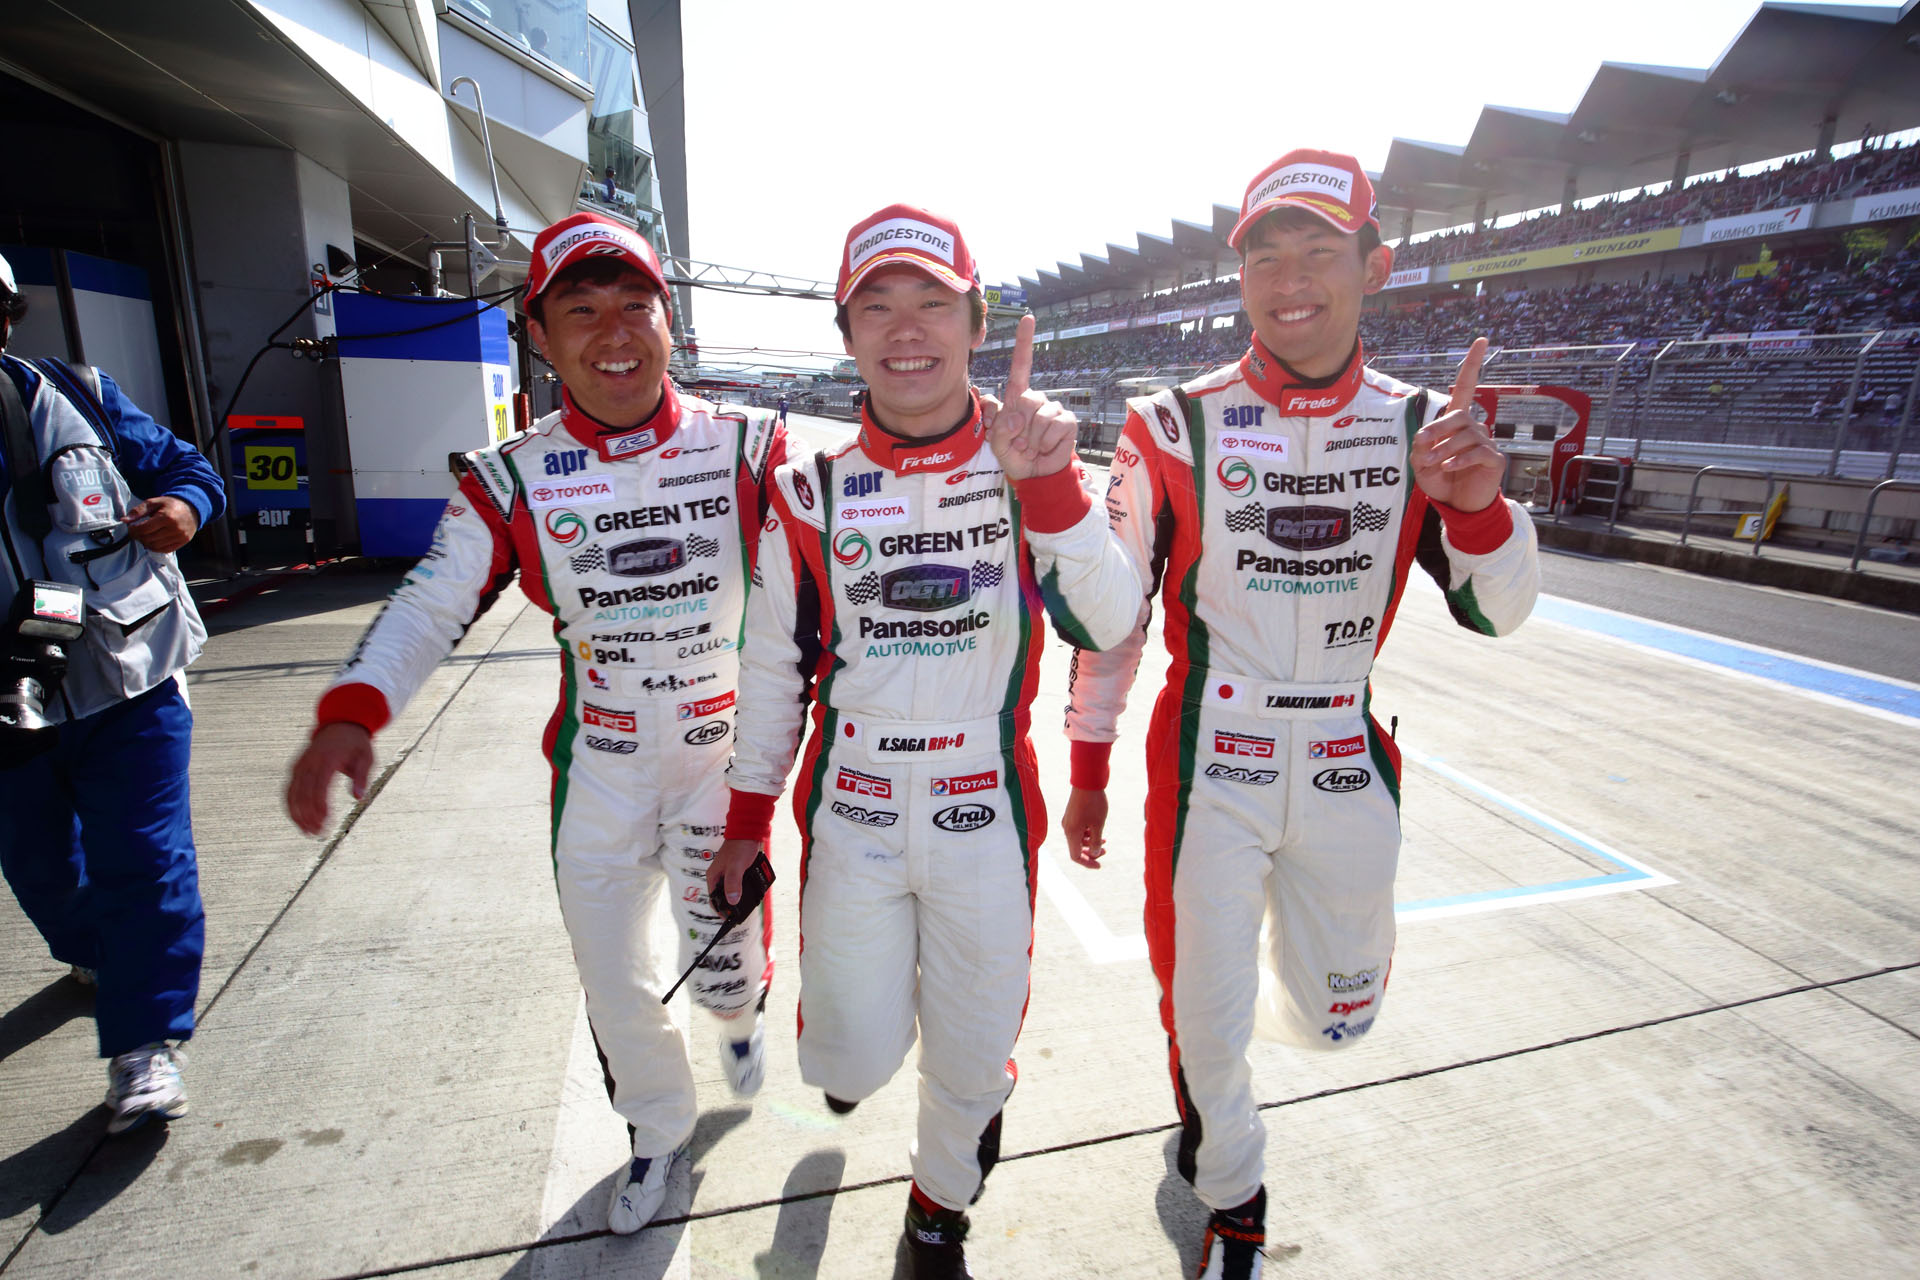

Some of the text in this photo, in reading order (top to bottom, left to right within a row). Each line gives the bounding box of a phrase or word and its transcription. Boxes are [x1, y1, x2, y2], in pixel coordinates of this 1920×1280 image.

[1251, 172, 1347, 209] BRIDGESTONE
[1711, 220, 1785, 241] KUMHO TIRE
[852, 228, 950, 259] BRIDGESTONE
[1585, 238, 1651, 256] DUNLOP
[1476, 257, 1527, 272] DUNLOP
[1391, 271, 1422, 285] YAMAHA
[988, 292, 999, 301] 30
[1287, 396, 1339, 410] Firelex
[495, 408, 508, 440] 30
[1240, 439, 1283, 453] TOYOTA
[1325, 436, 1398, 452] BRIDGESTONE
[249, 455, 293, 480] 30
[901, 451, 953, 470] Firelex
[60, 469, 113, 487] PHOTO
[658, 469, 731, 488] BRIDGESTONE
[1264, 466, 1400, 495] GREEN TEC
[556, 484, 610, 499] TOYOTA
[938, 487, 1004, 508] BRIDGESTON
[595, 496, 730, 533] GREEN TEC
[861, 505, 904, 518] TOYOTA
[879, 518, 1009, 557] GREEN TEC
[1237, 550, 1373, 576] Panasonic
[578, 573, 719, 608] Panasonic
[1246, 578, 1358, 594] AUTOMOTIVE
[594, 598, 708, 621] AUTOMOTIVE
[859, 609, 990, 639] Panasonic
[866, 636, 976, 658] AUTOMOTIVE
[696, 697, 734, 714] TOTAL
[585, 710, 634, 731] TRD
[691, 721, 725, 741] Arai
[878, 738, 925, 752] K.SAGA
[1217, 739, 1271, 757] TRD
[1329, 742, 1363, 754] TOTAL
[839, 766, 856, 775] Racing
[1206, 763, 1279, 784] RAYS
[1319, 769, 1365, 786] Arai
[840, 775, 889, 797] TRD
[952, 779, 994, 791] TOTAL
[831, 801, 898, 826] RAYS
[938, 807, 986, 827] Arai
